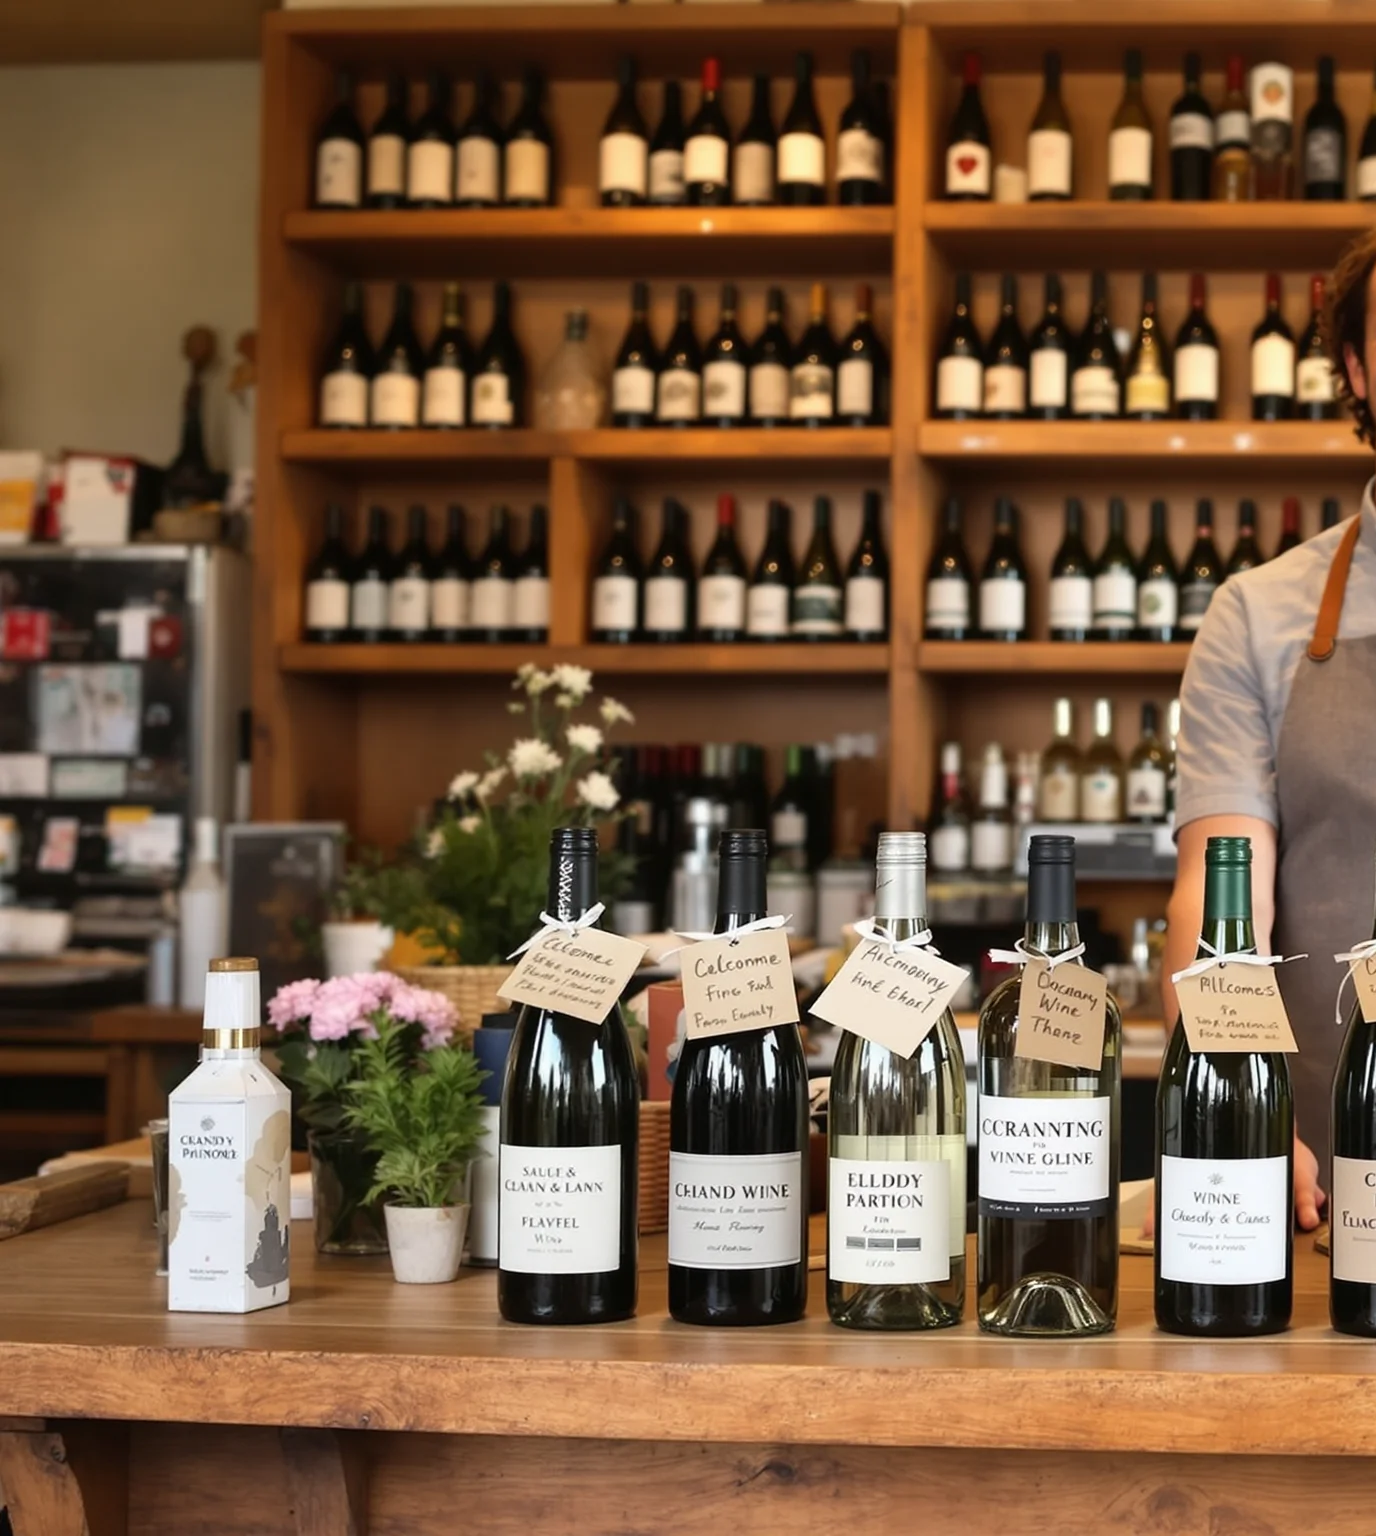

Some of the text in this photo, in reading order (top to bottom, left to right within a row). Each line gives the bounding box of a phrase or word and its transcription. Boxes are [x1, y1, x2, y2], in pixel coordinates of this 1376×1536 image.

[1039, 994, 1082, 1018] Wine
[566, 1167, 576, 1178] &
[550, 1182, 560, 1193] &
[846, 1193, 924, 1209] PARTION
